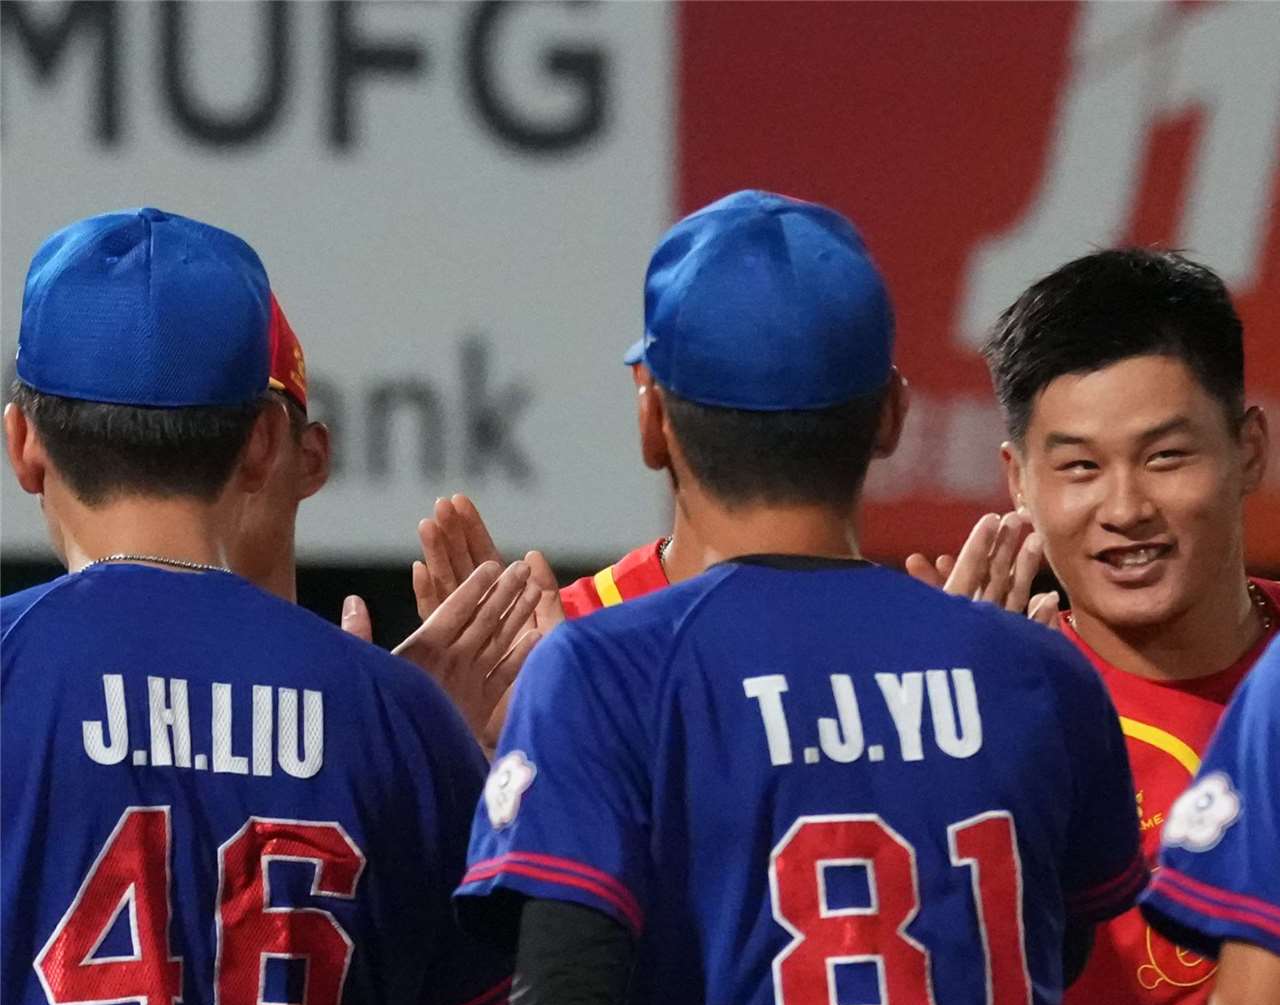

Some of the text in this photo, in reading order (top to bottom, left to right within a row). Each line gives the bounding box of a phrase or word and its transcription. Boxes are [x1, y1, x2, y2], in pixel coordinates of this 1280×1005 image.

[0, 0, 610, 155] MUFG
[82, 674, 324, 779] J.H.LIU
[743, 668, 984, 766] T.J.YU
